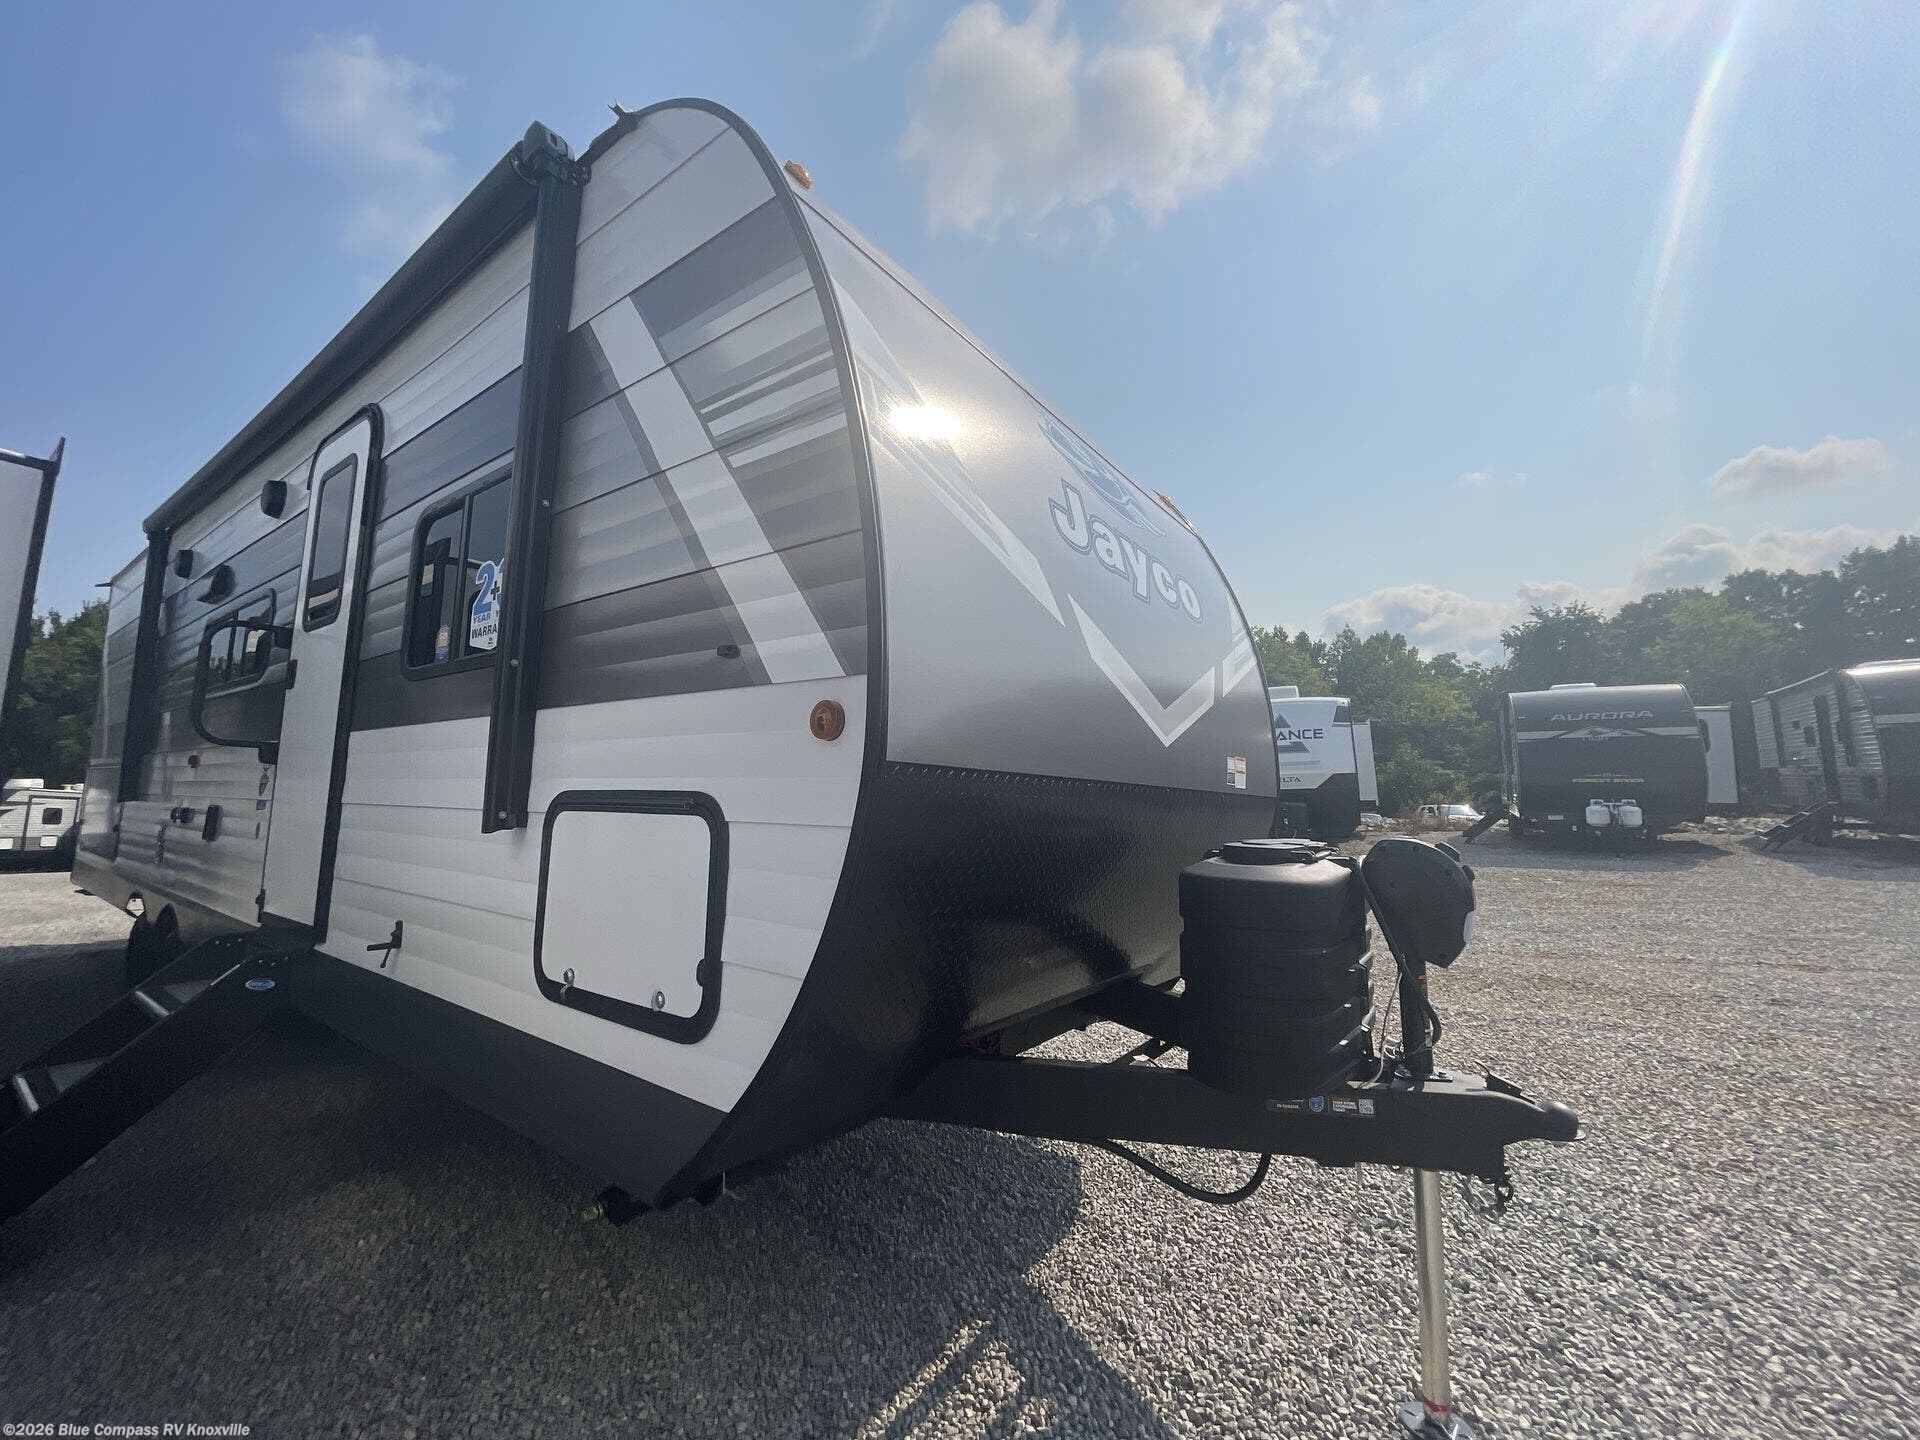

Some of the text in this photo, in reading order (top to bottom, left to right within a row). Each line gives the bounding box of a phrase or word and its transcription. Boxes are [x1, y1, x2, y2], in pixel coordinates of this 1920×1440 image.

[1049, 477, 1203, 623] Jayco
[473, 612, 491, 624] YEAR
[471, 623, 498, 639] WARRA
[1550, 710, 1654, 722] AURORA
[1277, 728, 1324, 741] ANCE
